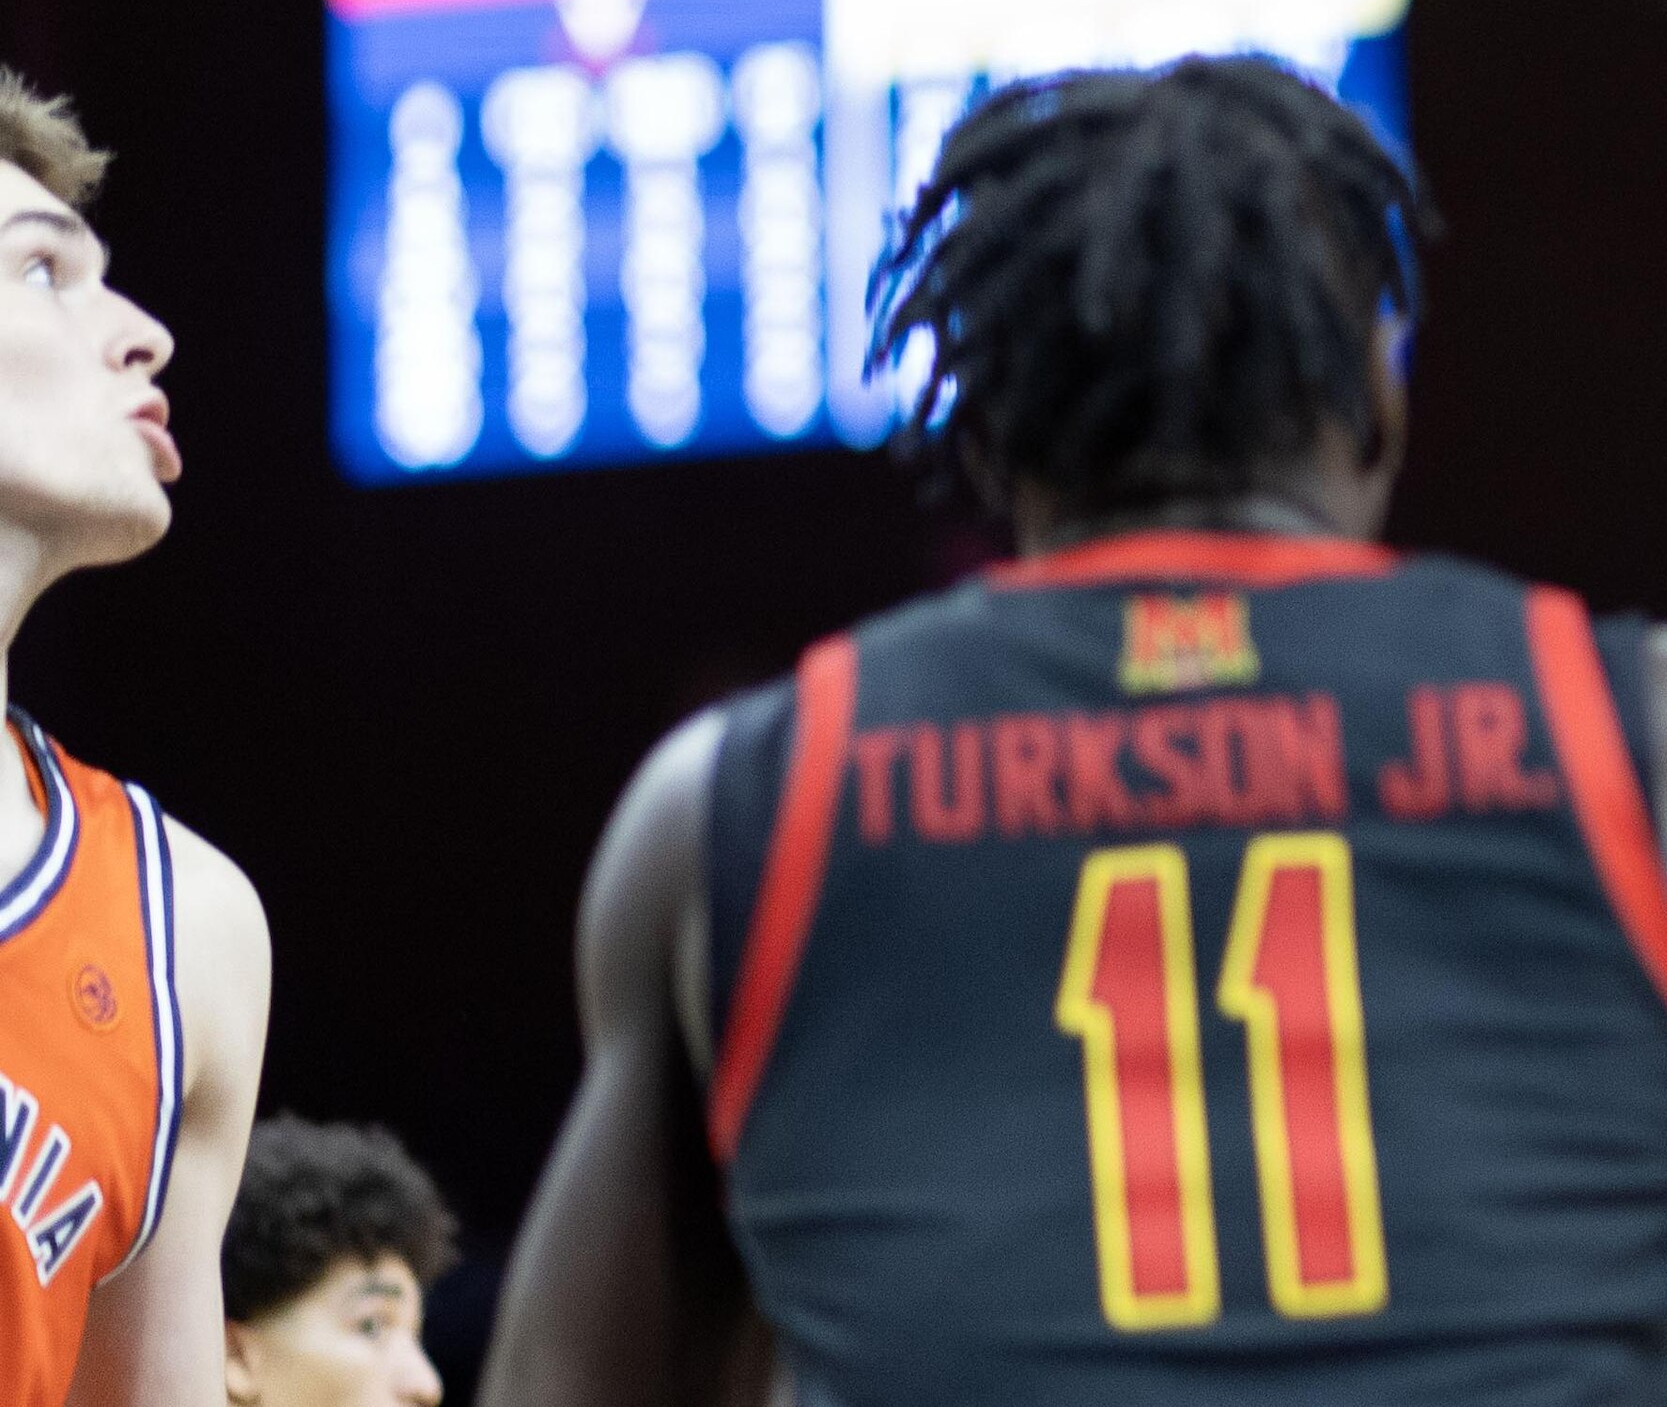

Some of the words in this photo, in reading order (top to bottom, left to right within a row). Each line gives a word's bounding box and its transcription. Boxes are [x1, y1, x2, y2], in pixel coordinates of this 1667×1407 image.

[846, 692, 1347, 843] TURKSON
[1378, 679, 1557, 824] JR.
[1056, 831, 1390, 1332] 11
